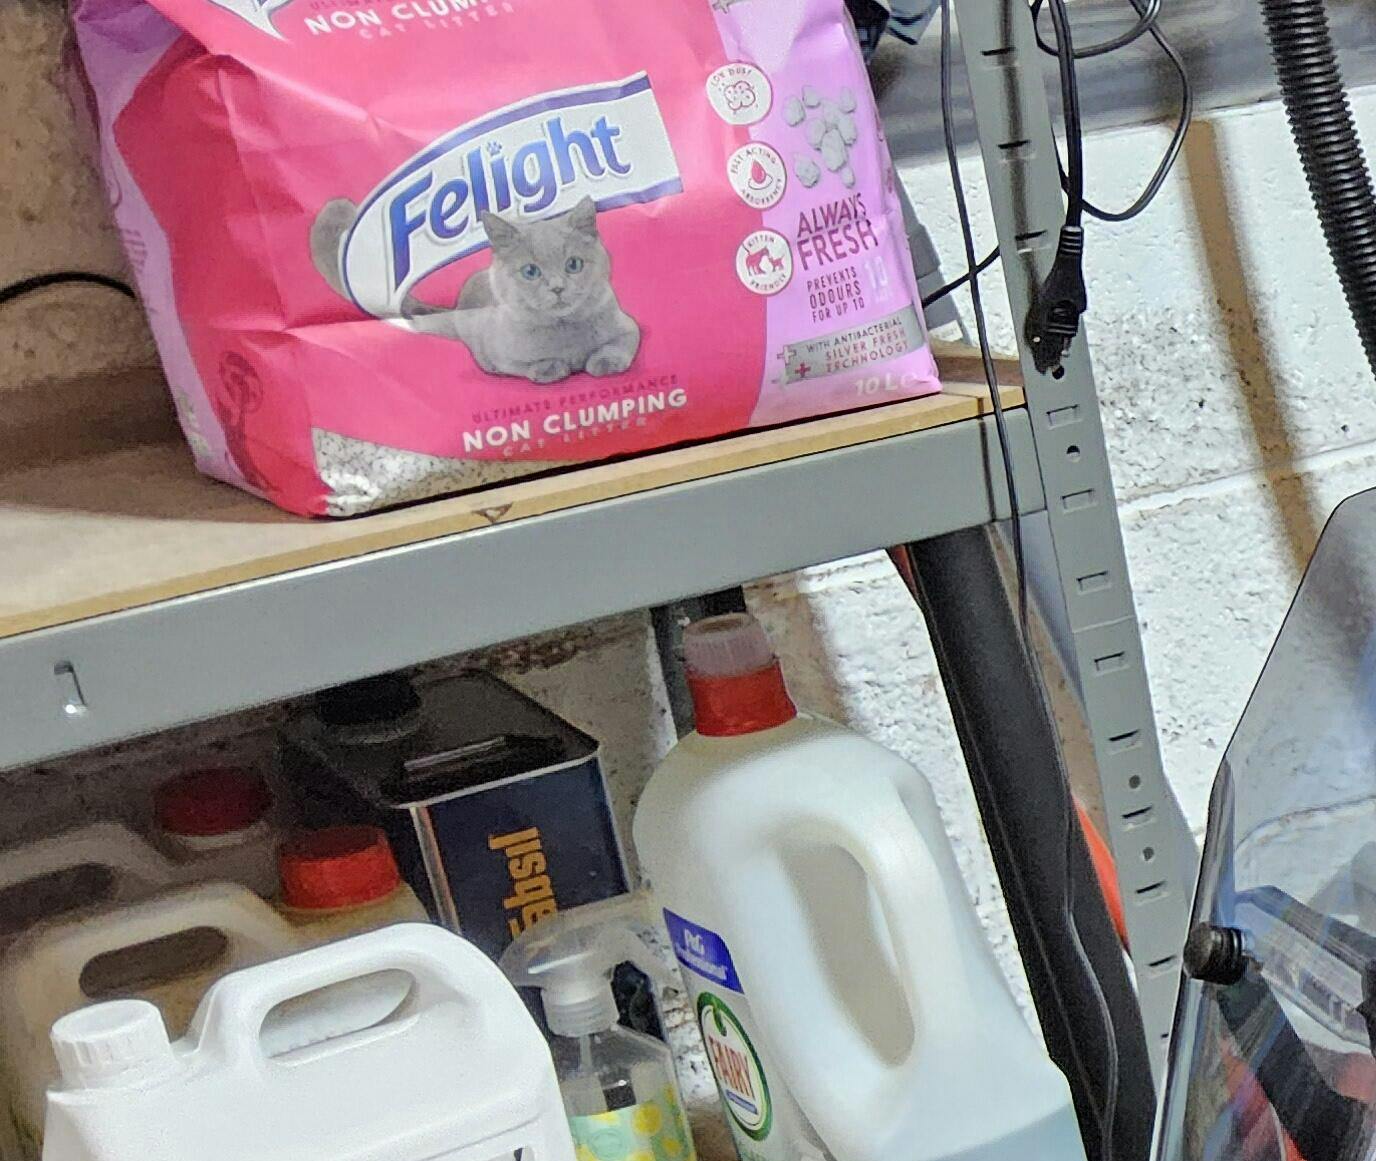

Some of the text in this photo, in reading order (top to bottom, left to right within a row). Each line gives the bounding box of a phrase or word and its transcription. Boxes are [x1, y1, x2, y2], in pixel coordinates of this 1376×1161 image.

[303, 0, 488, 36] NON CLUM
[745, 147, 778, 165] ACTING
[388, 115, 633, 291] Felight
[796, 192, 867, 238] ALWAYS
[796, 218, 879, 271] FRESH
[806, 265, 858, 292] PREVENTS
[809, 280, 862, 309] ODOURS
[811, 308, 831, 324] FOR
[836, 303, 849, 317] UP
[853, 296, 866, 311] TO
[805, 316, 903, 353] WITH ANTIBACTERIAL
[825, 329, 907, 362] SILVER FRESH
[826, 342, 910, 373] TECHNOLOGY
[471, 373, 680, 424] ULTIMATE PERFORMANCE
[461, 387, 689, 452] NON CLUMPING
